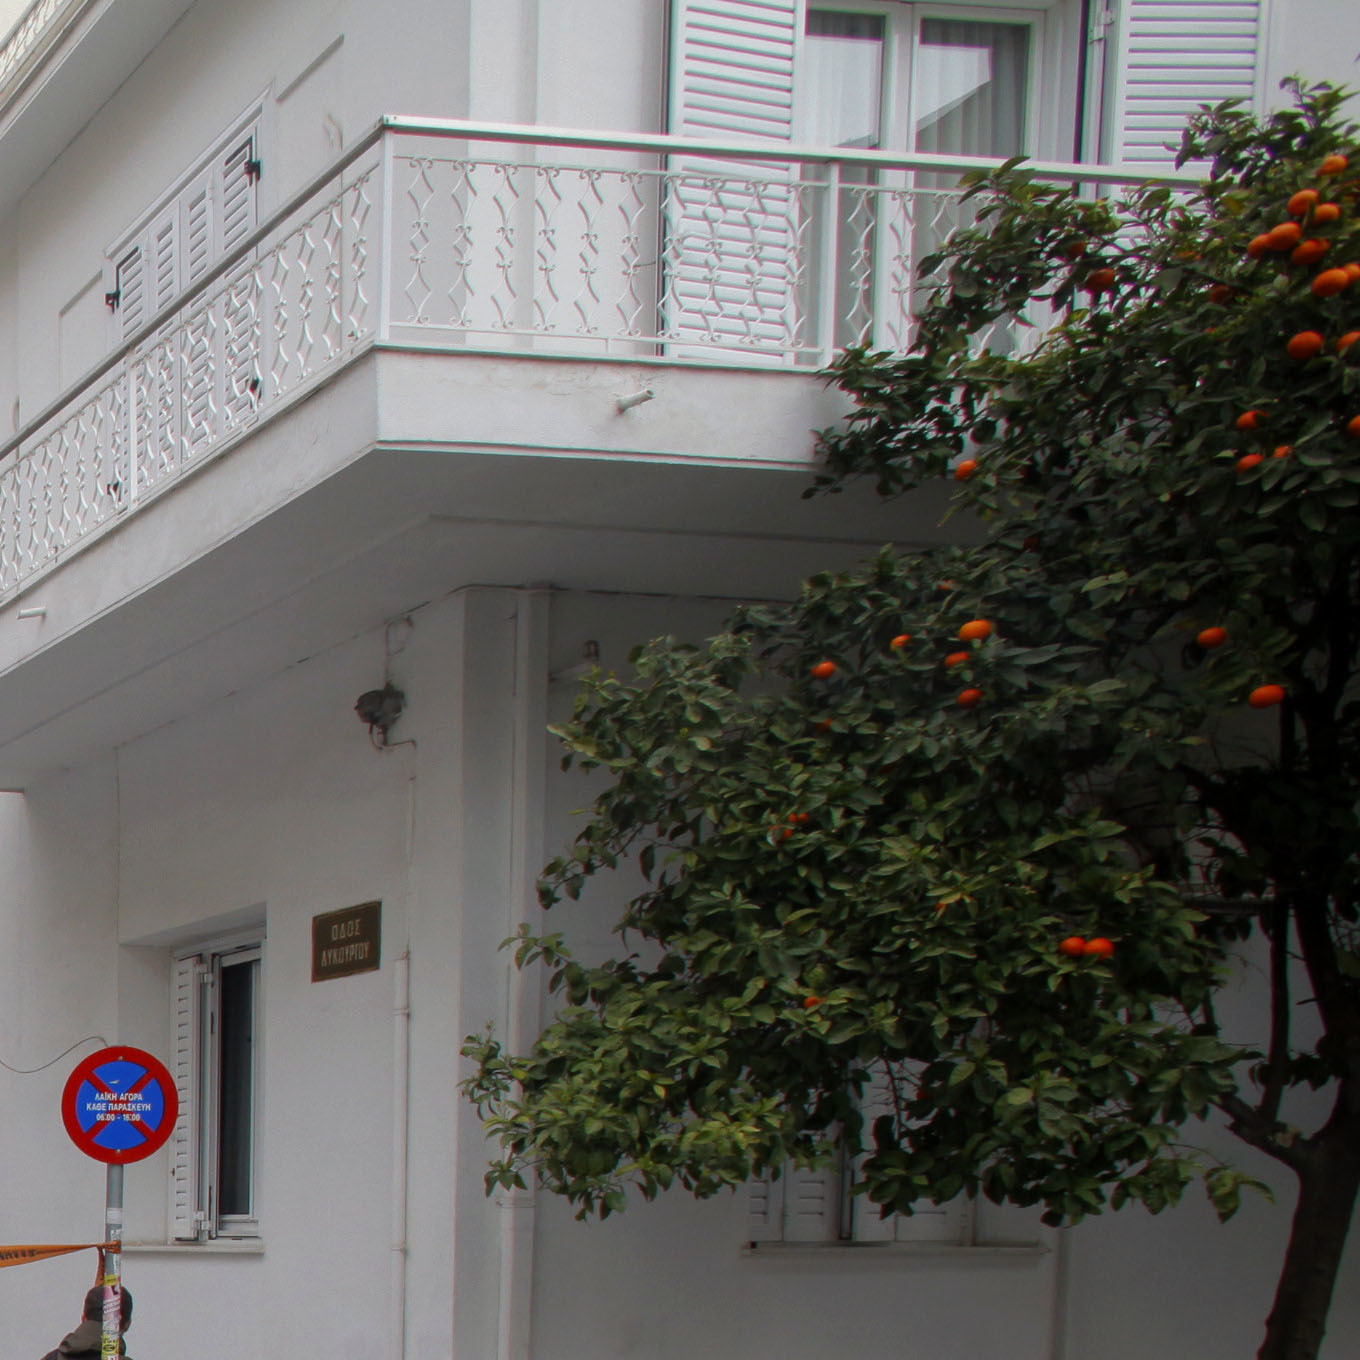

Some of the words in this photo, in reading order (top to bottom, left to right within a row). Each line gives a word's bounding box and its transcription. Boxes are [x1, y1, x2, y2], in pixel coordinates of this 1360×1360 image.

[332, 918, 361, 941] ΟΔΟΣ
[321, 941, 370, 967] ΛΥΚΟΥΡΓΟΥ
[95, 1092, 117, 1101] ΛΑΪΚΗ
[119, 1093, 142, 1101] ΑΓΟΡΑ
[86, 1103, 106, 1111] ΚΑΘΕ
[108, 1103, 151, 1111] ΠΑΡΑΣΚΕΥΗ
